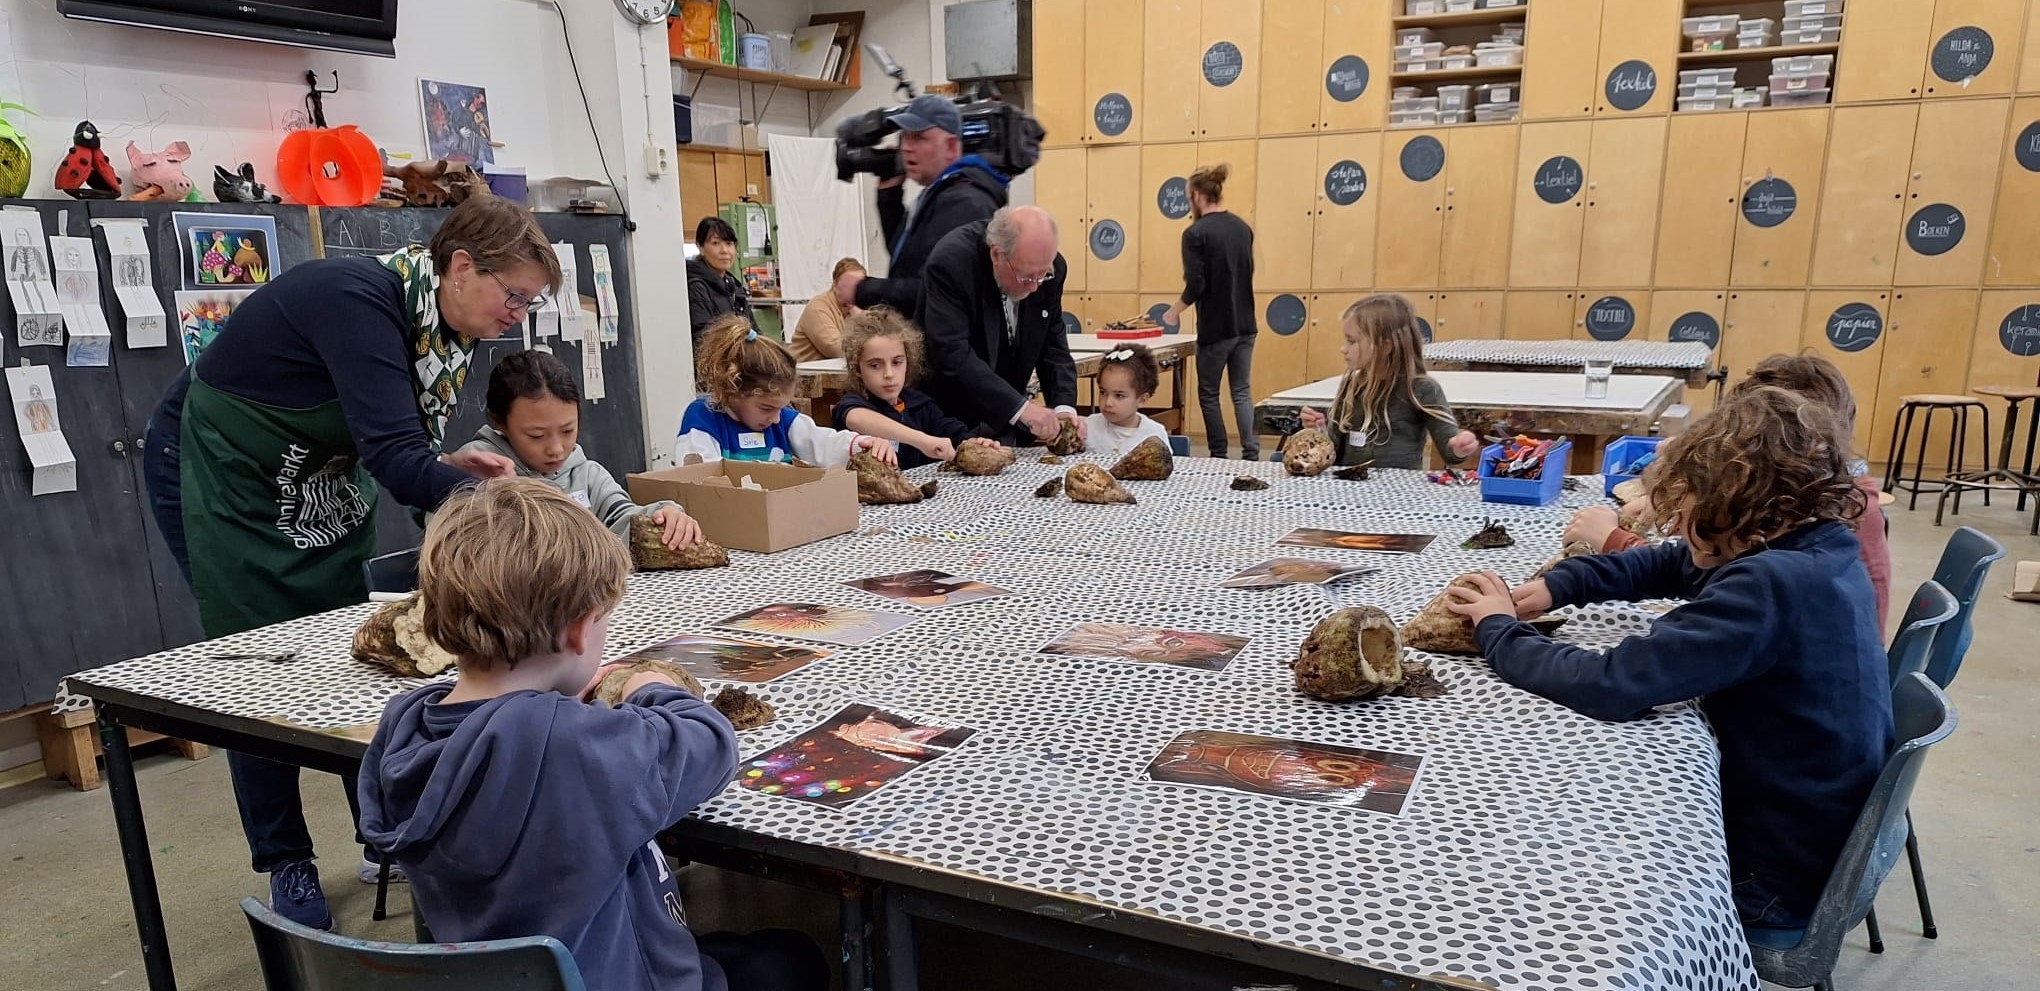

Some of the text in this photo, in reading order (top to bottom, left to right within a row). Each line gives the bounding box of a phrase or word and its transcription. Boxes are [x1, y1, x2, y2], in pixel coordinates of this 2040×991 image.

[632, 2, 638, 11] 7
[653, 6, 660, 15] 5
[642, 8, 650, 19] 6
